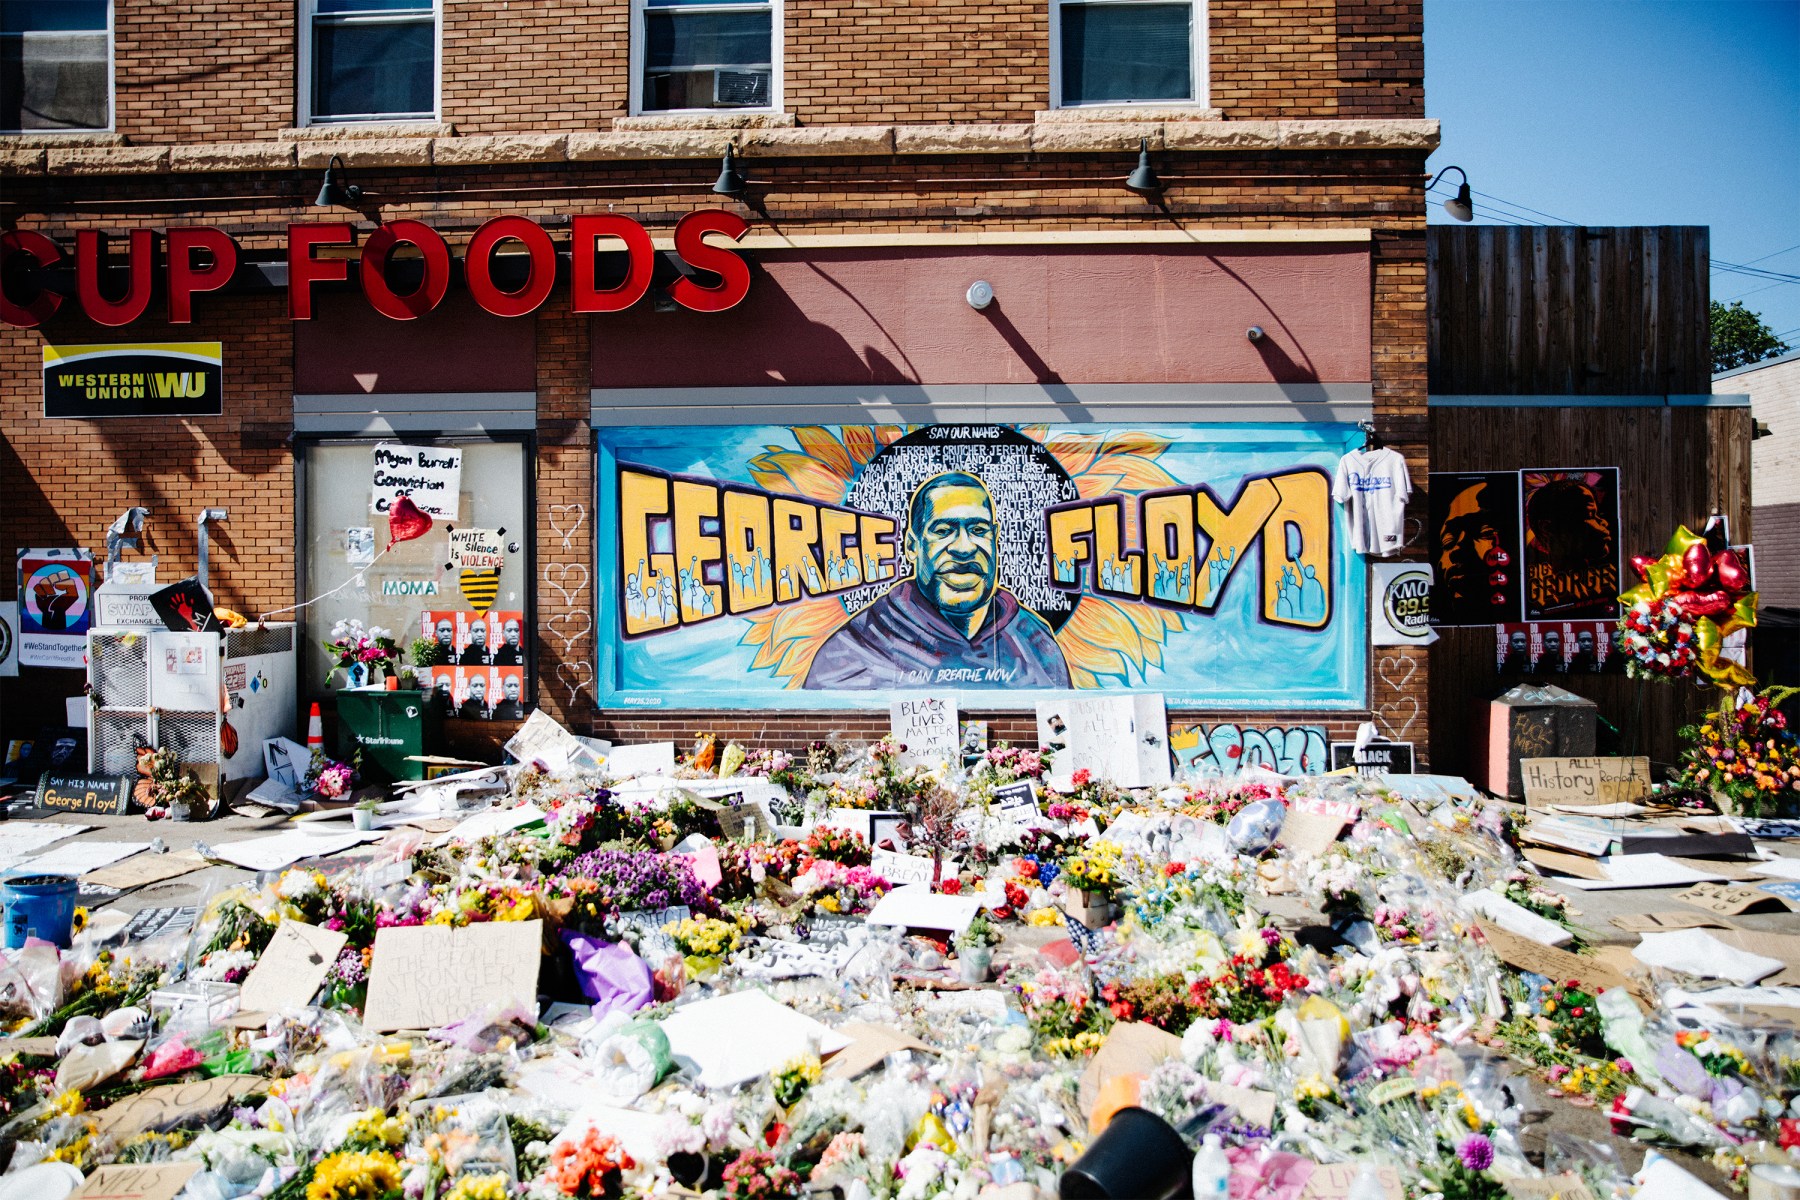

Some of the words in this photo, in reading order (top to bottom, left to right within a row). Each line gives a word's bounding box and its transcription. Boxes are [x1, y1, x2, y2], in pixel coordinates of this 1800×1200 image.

[0, 227, 236, 328] CUP
[288, 209, 753, 321] FOODS
[58, 374, 145, 387] WESTERN
[155, 372, 206, 399] WU
[85, 386, 145, 400] UNION
[929, 427, 949, 439] SAY
[950, 426, 971, 439] OUR
[972, 426, 999, 439] NAMES
[893, 445, 940, 456] TERRENCE
[942, 445, 986, 456] CRUTCHER
[990, 445, 1028, 456] JEREMY
[942, 455, 992, 464] PHILANDO
[1000, 455, 1036, 464] CASTILE
[864, 464, 884, 473] AKAI
[984, 464, 1021, 473] FREDDIE
[1022, 463, 1047, 474] GREY
[860, 473, 899, 483] MICHAEL
[1348, 472, 1391, 493] Dodgers
[853, 482, 885, 493] TYISHA
[987, 481, 1026, 491] BREONNA
[1026, 481, 1059, 491] TAYLOR
[847, 492, 869, 503] ERIC
[870, 492, 908, 502] GARNER
[992, 490, 1031, 500] SHANTEL
[1032, 490, 1058, 500] DAVIS
[853, 500, 891, 511] SANDRA
[996, 510, 1022, 520] REKIA
[451, 533, 485, 543] WHITE
[998, 531, 1032, 542] SHELLY
[617, 461, 900, 640] GEORGE
[998, 542, 1030, 554] TAMAR
[1045, 464, 1334, 632] FLOYD
[460, 555, 504, 568] VIOLENCE
[998, 554, 1039, 566] TANISHA
[998, 565, 1034, 576] TARIKA
[998, 576, 1029, 588] ALTON
[1527, 565, 1617, 606] GEORGE
[384, 581, 437, 596] MOMA
[107, 603, 154, 617] SWAP
[1023, 599, 1072, 611] KATHRYN
[1496, 623, 1505, 633] DO
[1530, 623, 1538, 633] DO
[1563, 622, 1571, 632] DO
[1596, 622, 1604, 632] DO
[1496, 633, 1508, 643] YOU
[1530, 633, 1542, 643] YOU
[1563, 632, 1575, 643] YOU
[1596, 632, 1608, 643] YOU
[1496, 644, 1507, 654] SEE
[1530, 643, 1543, 654] FEEL
[1563, 643, 1579, 653] HEAR
[1597, 643, 1608, 653] SEE
[1496, 654, 1505, 663] US
[1530, 653, 1538, 663] US
[1564, 653, 1572, 663] US
[1597, 653, 1606, 662] US
[257, 670, 262, 679] 4
[908, 668, 934, 683] CAN
[935, 667, 985, 683] BREATHE
[985, 667, 1018, 683] NOW
[901, 699, 946, 716] BLACK
[912, 713, 944, 727] LIVES
[906, 724, 954, 739] MATTER
[1515, 714, 1554, 745] FUCK
[365, 737, 404, 745] StarTribune
[926, 737, 939, 746] AT
[1514, 735, 1545, 757] MPD
[1569, 759, 1593, 769] ALL
[50, 777, 65, 786] SAY
[68, 780, 85, 788] HIS
[1529, 761, 1595, 796] History
[44, 789, 83, 811] George
[84, 792, 118, 813] Floyd
[385, 964, 516, 996] STRONGER
